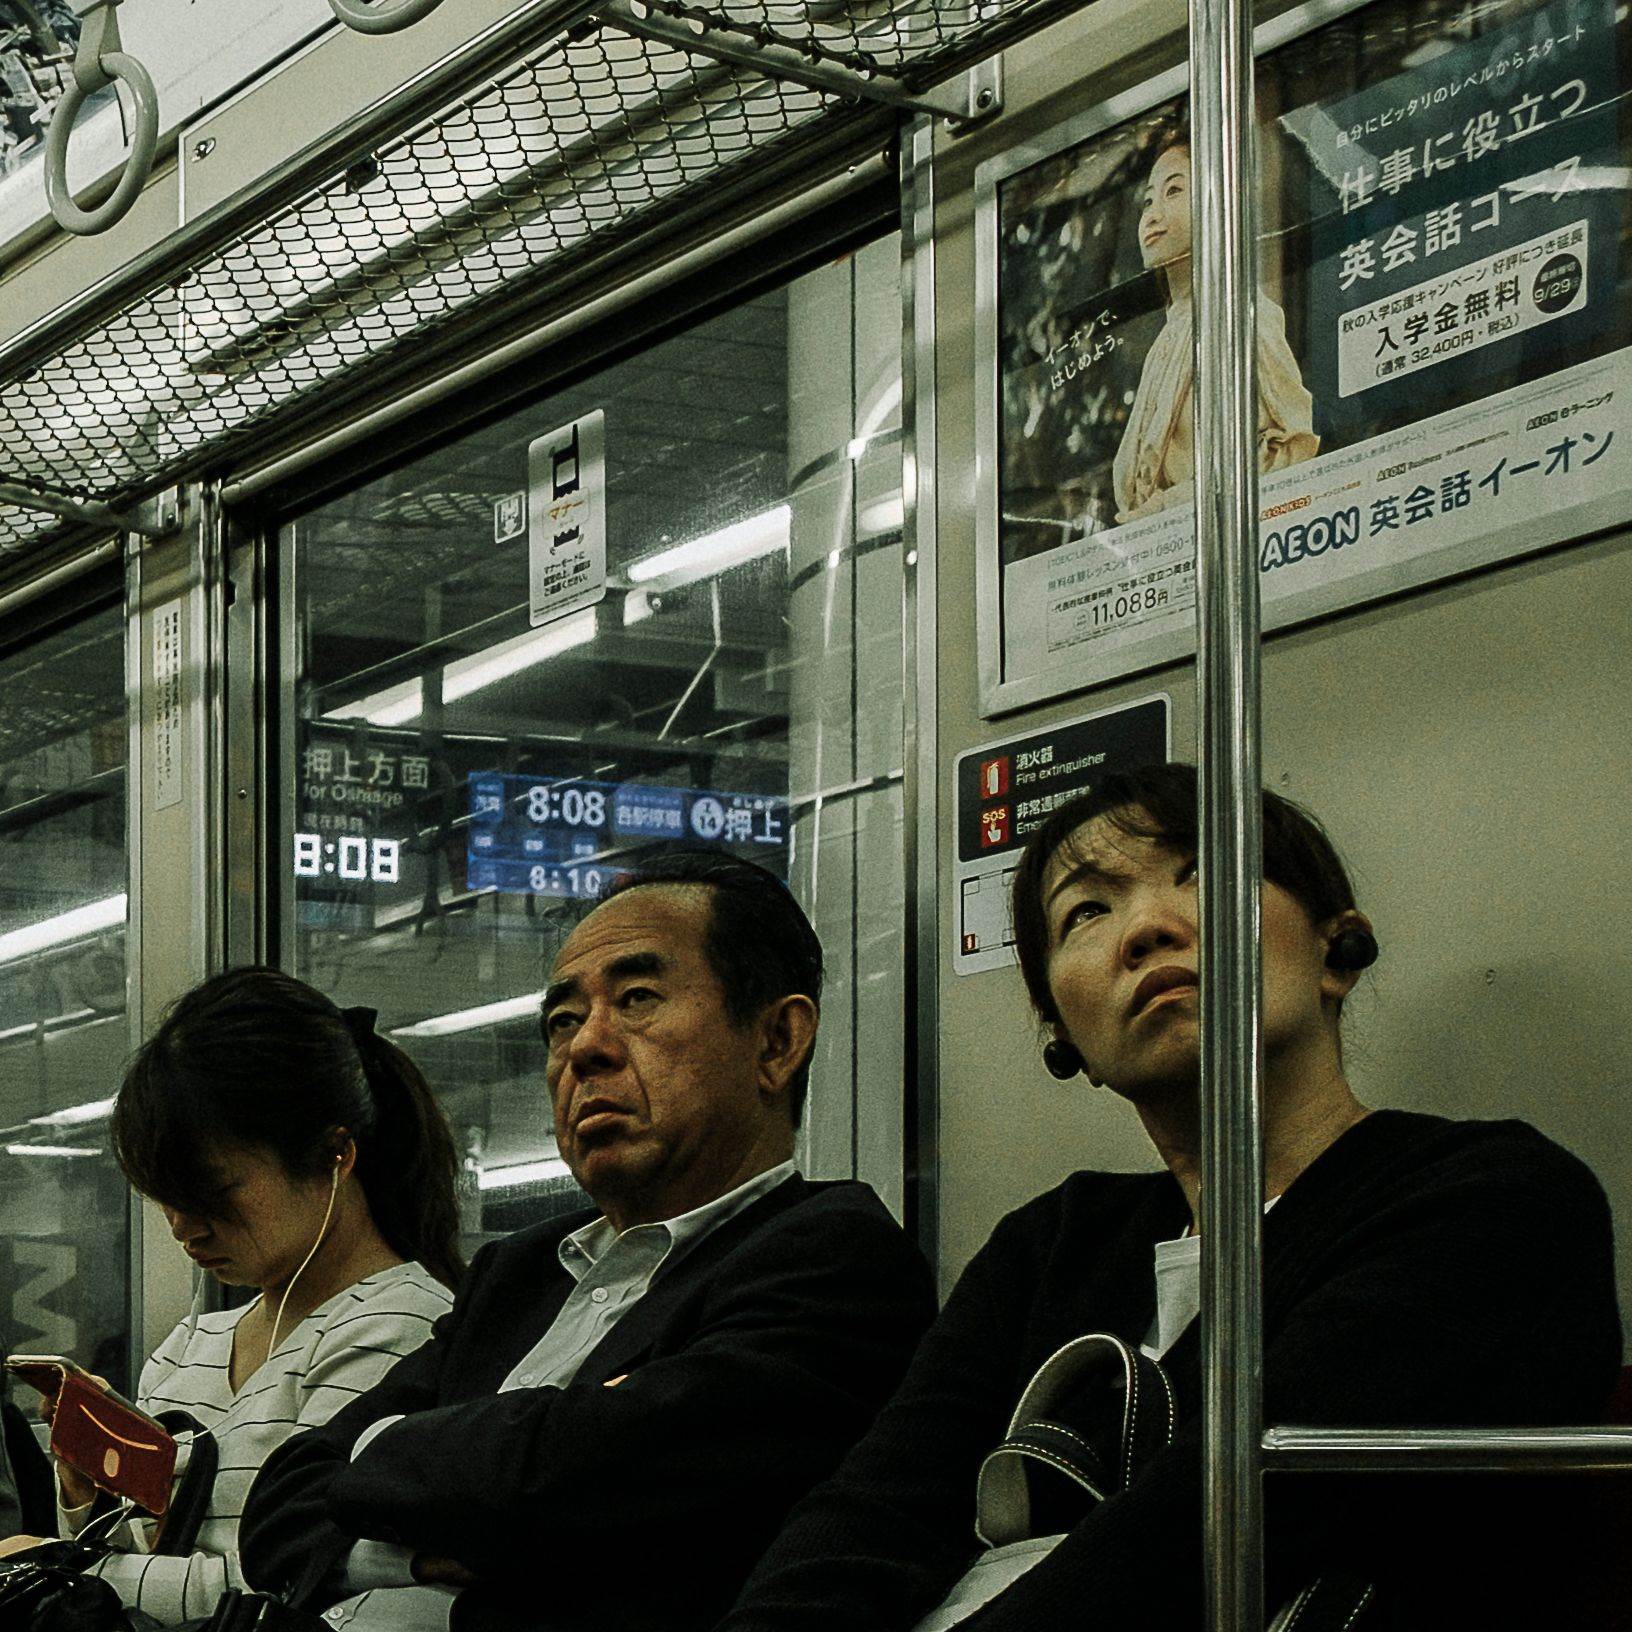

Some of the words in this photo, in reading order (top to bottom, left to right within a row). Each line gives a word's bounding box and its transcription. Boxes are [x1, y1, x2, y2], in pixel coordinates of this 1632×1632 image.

[1336, 24, 1585, 148] 自分にピッタリのレベルからスタート
[1338, 79, 1586, 214] 仕事に役立つ
[1338, 156, 1582, 291] 英会話コース
[1045, 309, 1118, 364] イーオンで、
[1375, 276, 1521, 358] 入学金無料
[1051, 335, 1124, 390] はじめよう。
[1260, 506, 1360, 573] AEON
[303, 748, 429, 788] 押上方面
[1016, 771, 1037, 786] Fire
[1038, 751, 1107, 780] extinguisher
[527, 785, 606, 827] 8:08
[982, 808, 1006, 824] SOS
[294, 833, 400, 884] 8:08
